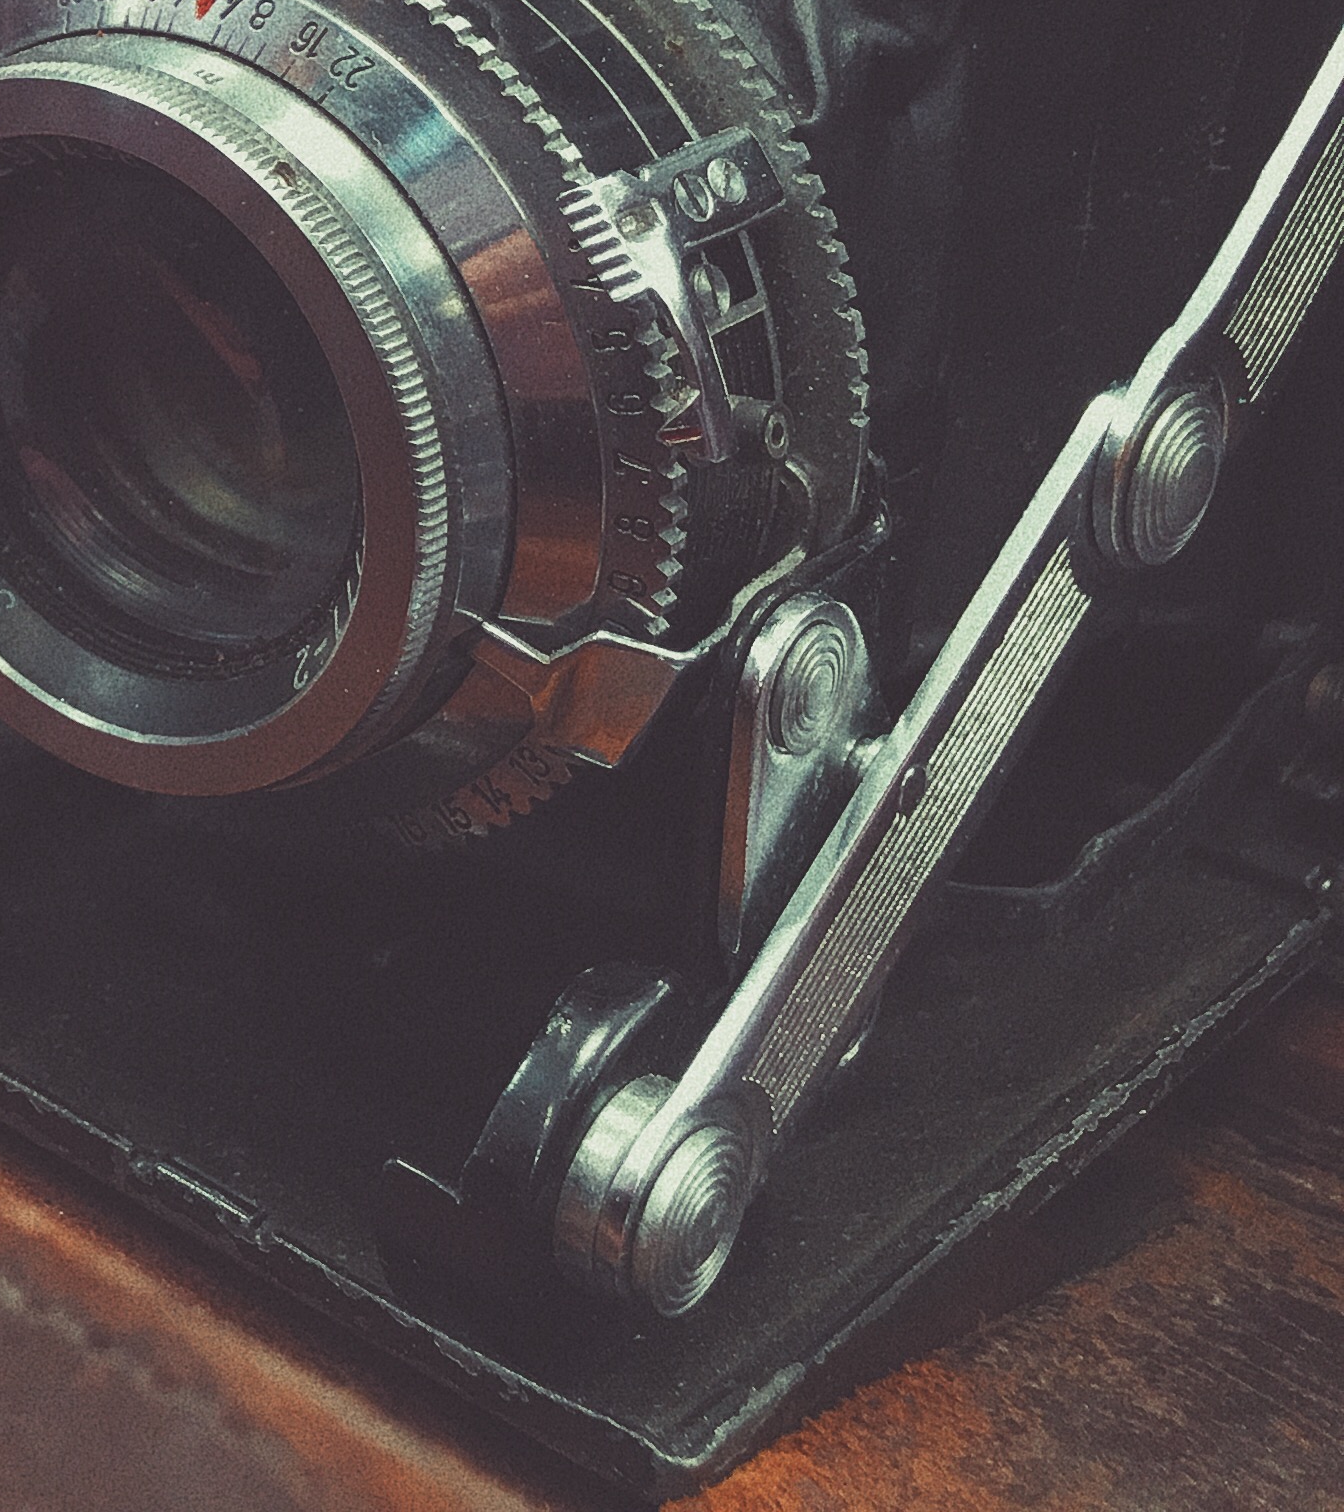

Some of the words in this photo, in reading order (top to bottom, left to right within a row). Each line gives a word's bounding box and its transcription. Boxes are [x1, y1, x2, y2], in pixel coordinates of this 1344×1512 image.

[289, 21, 328, 59] 16
[329, 45, 375, 89] 22
[431, 798, 473, 835] 15
[472, 774, 513, 814] 14
[509, 746, 550, 786] 13
